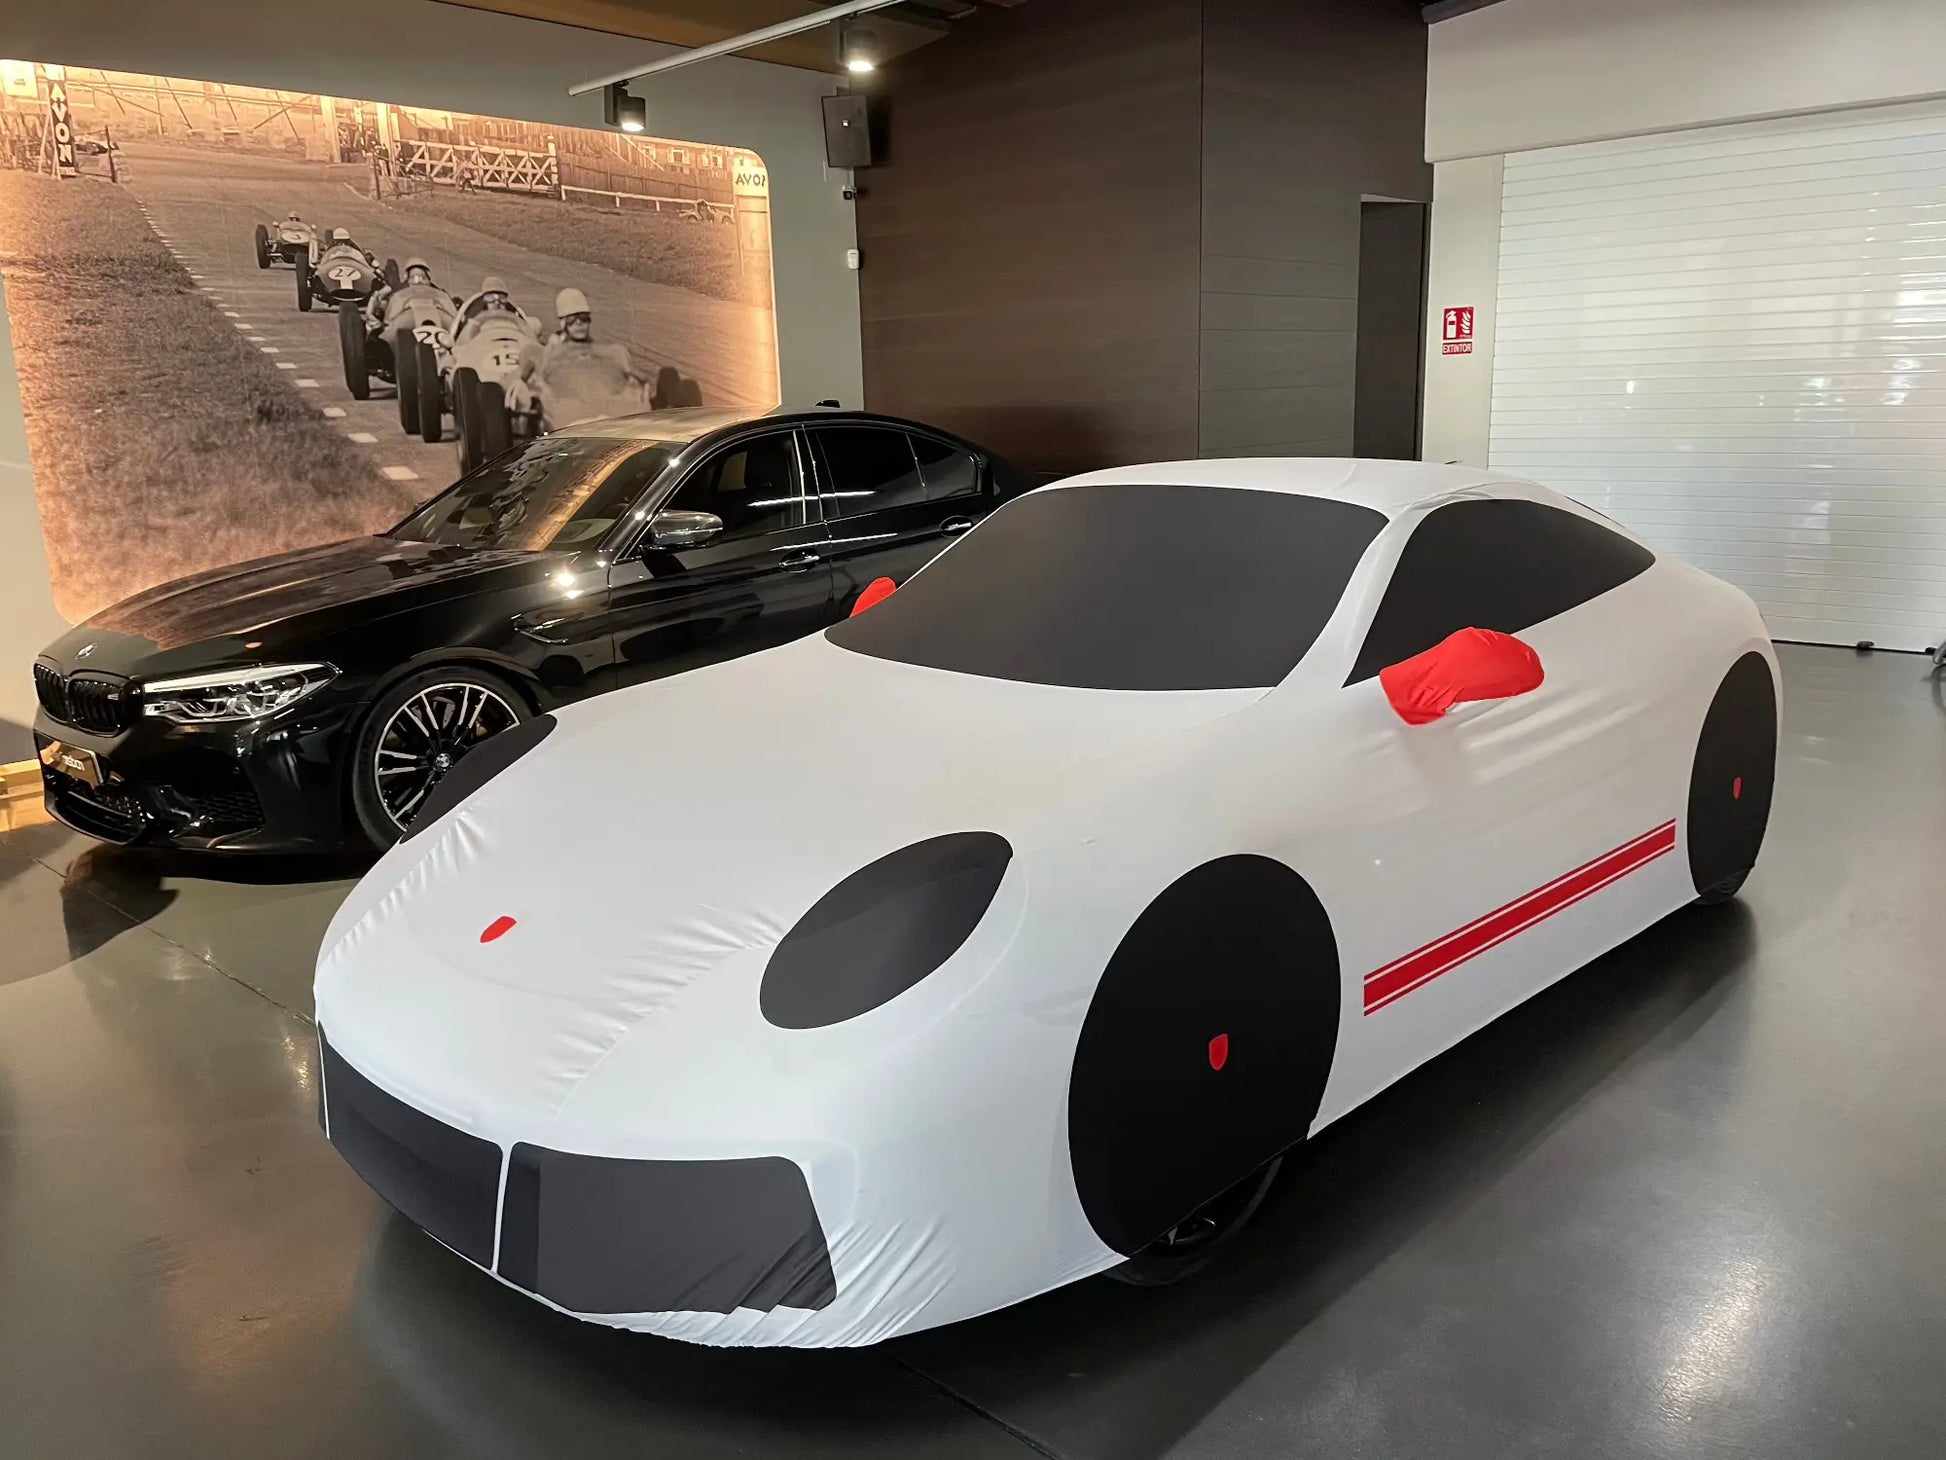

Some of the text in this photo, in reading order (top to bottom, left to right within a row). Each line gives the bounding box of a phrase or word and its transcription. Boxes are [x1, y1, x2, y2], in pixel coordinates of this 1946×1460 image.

[50, 83, 73, 164] AVON
[1443, 343, 1471, 354] EXTINTOR
[492, 353, 520, 366] 15
